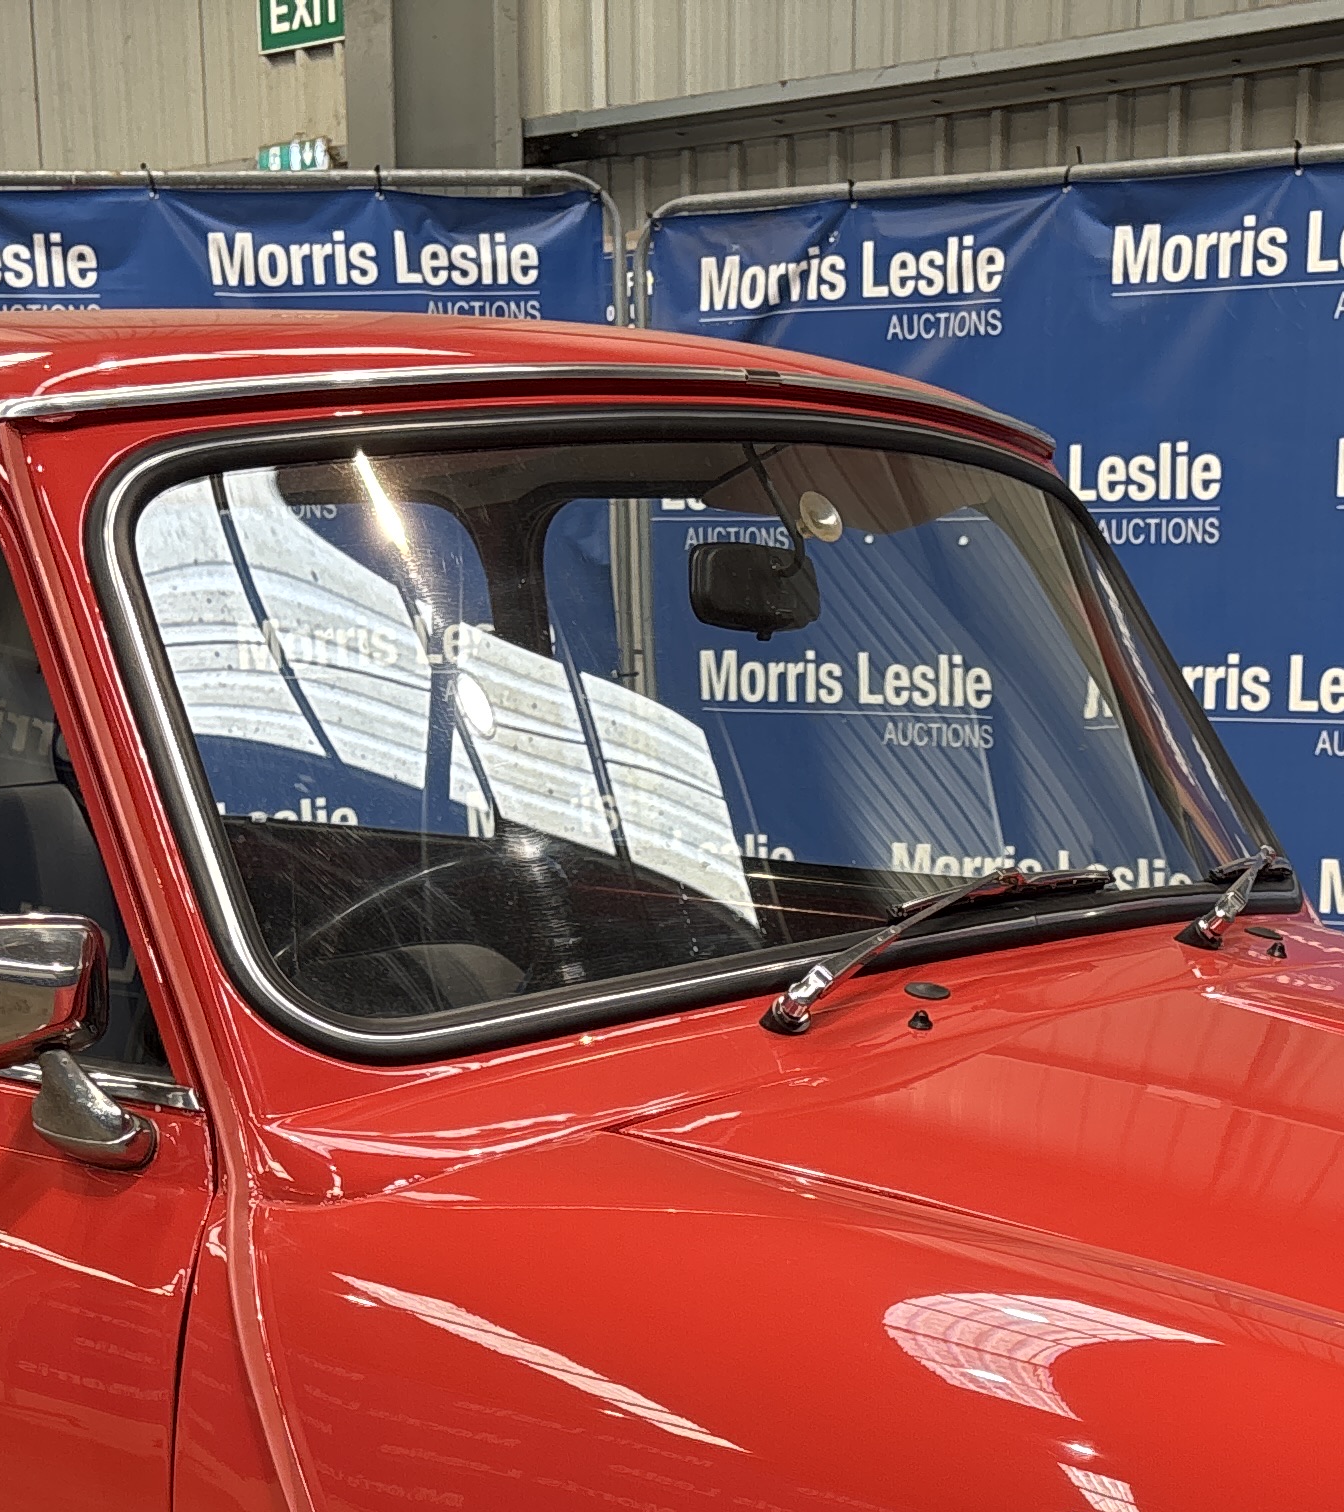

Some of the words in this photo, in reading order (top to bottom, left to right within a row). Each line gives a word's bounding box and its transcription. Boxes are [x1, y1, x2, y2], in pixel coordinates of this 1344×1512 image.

[207, 229, 379, 287] Morris
[393, 229, 539, 286] Leslie
[699, 240, 847, 313] Morris
[862, 234, 1006, 298] Leslie
[1111, 214, 1288, 285] Morris
[426, 299, 543, 323] AUCTIONS
[886, 308, 1003, 341] AUCTIONS
[1068, 440, 1222, 502] Leslie
[1098, 516, 1220, 545] AUCTIONS
[699, 649, 844, 704] Morris
[857, 651, 993, 709] Leslie
[881, 720, 994, 750] AUCTIONS
